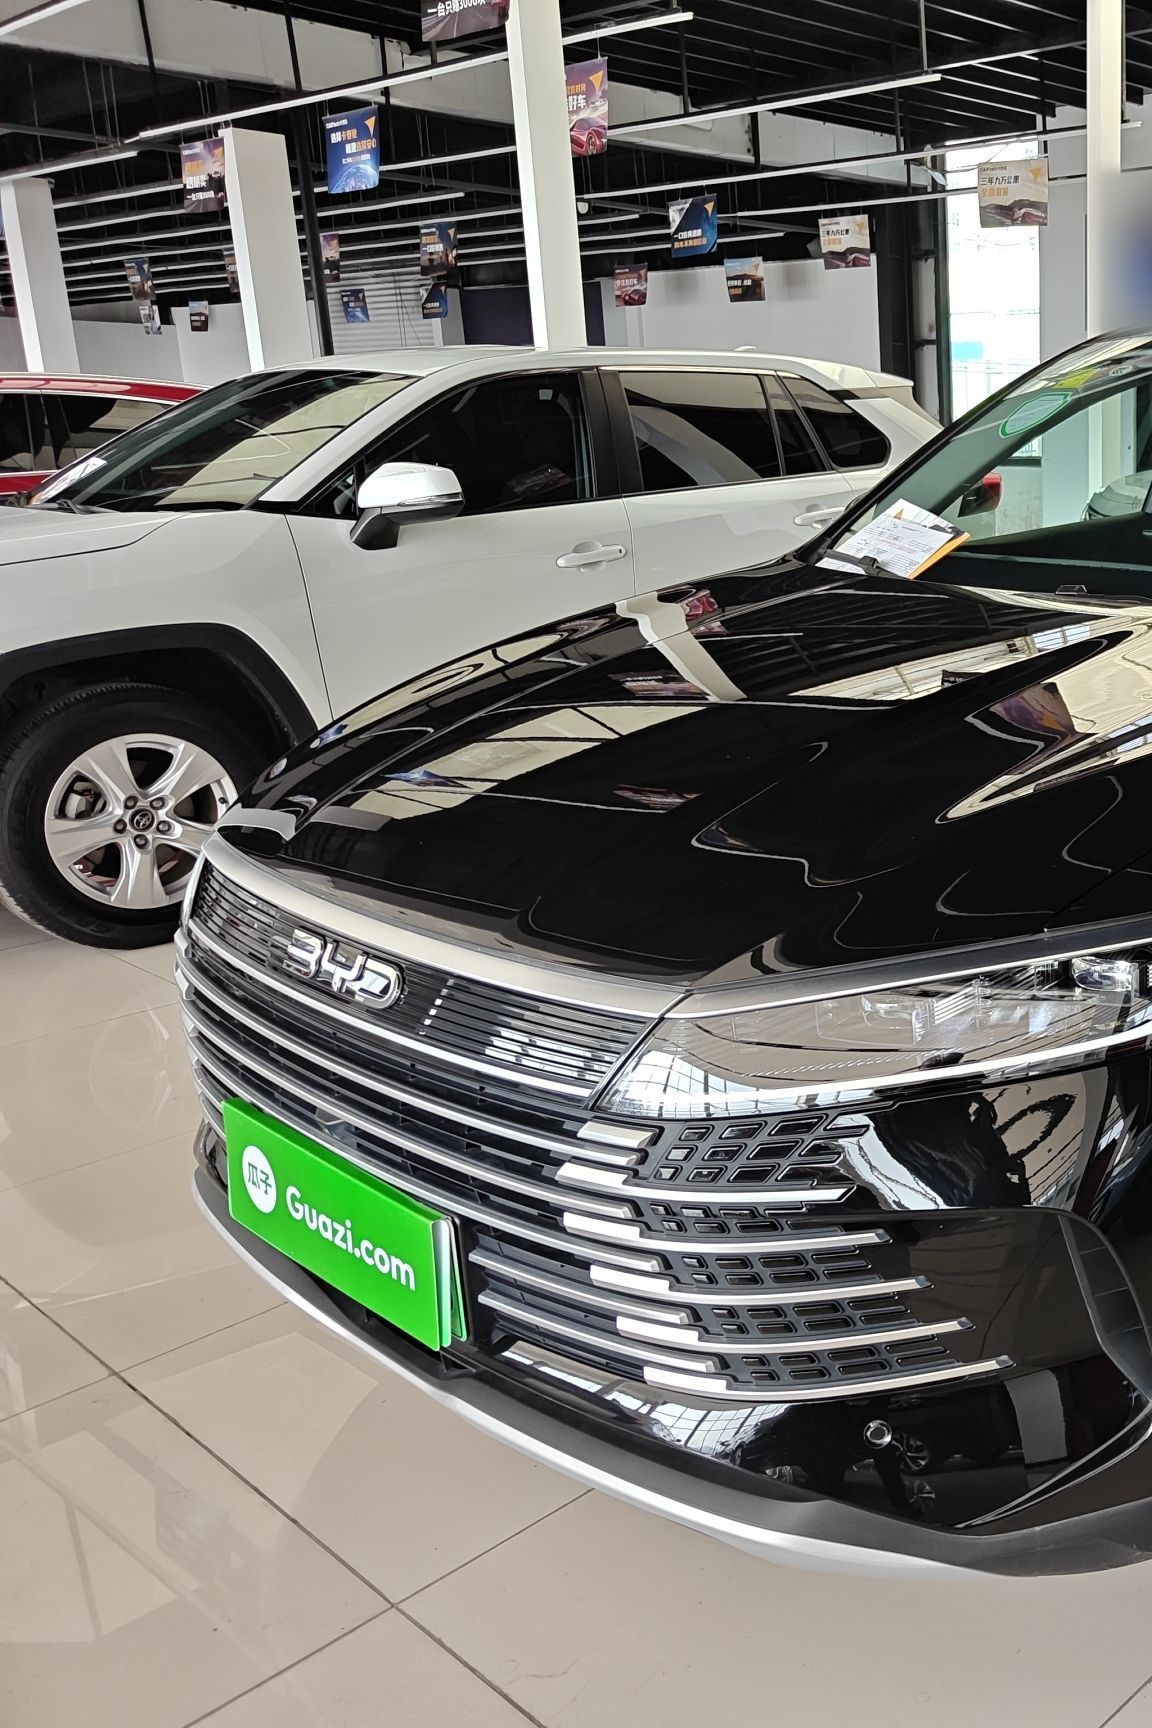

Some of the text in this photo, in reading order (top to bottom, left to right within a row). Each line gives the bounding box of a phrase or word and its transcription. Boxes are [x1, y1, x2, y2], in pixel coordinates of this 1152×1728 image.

[283, 929, 403, 1009] BYD
[247, 1161, 273, 1195] 瓜子
[285, 1185, 416, 1291] Guazi.com
